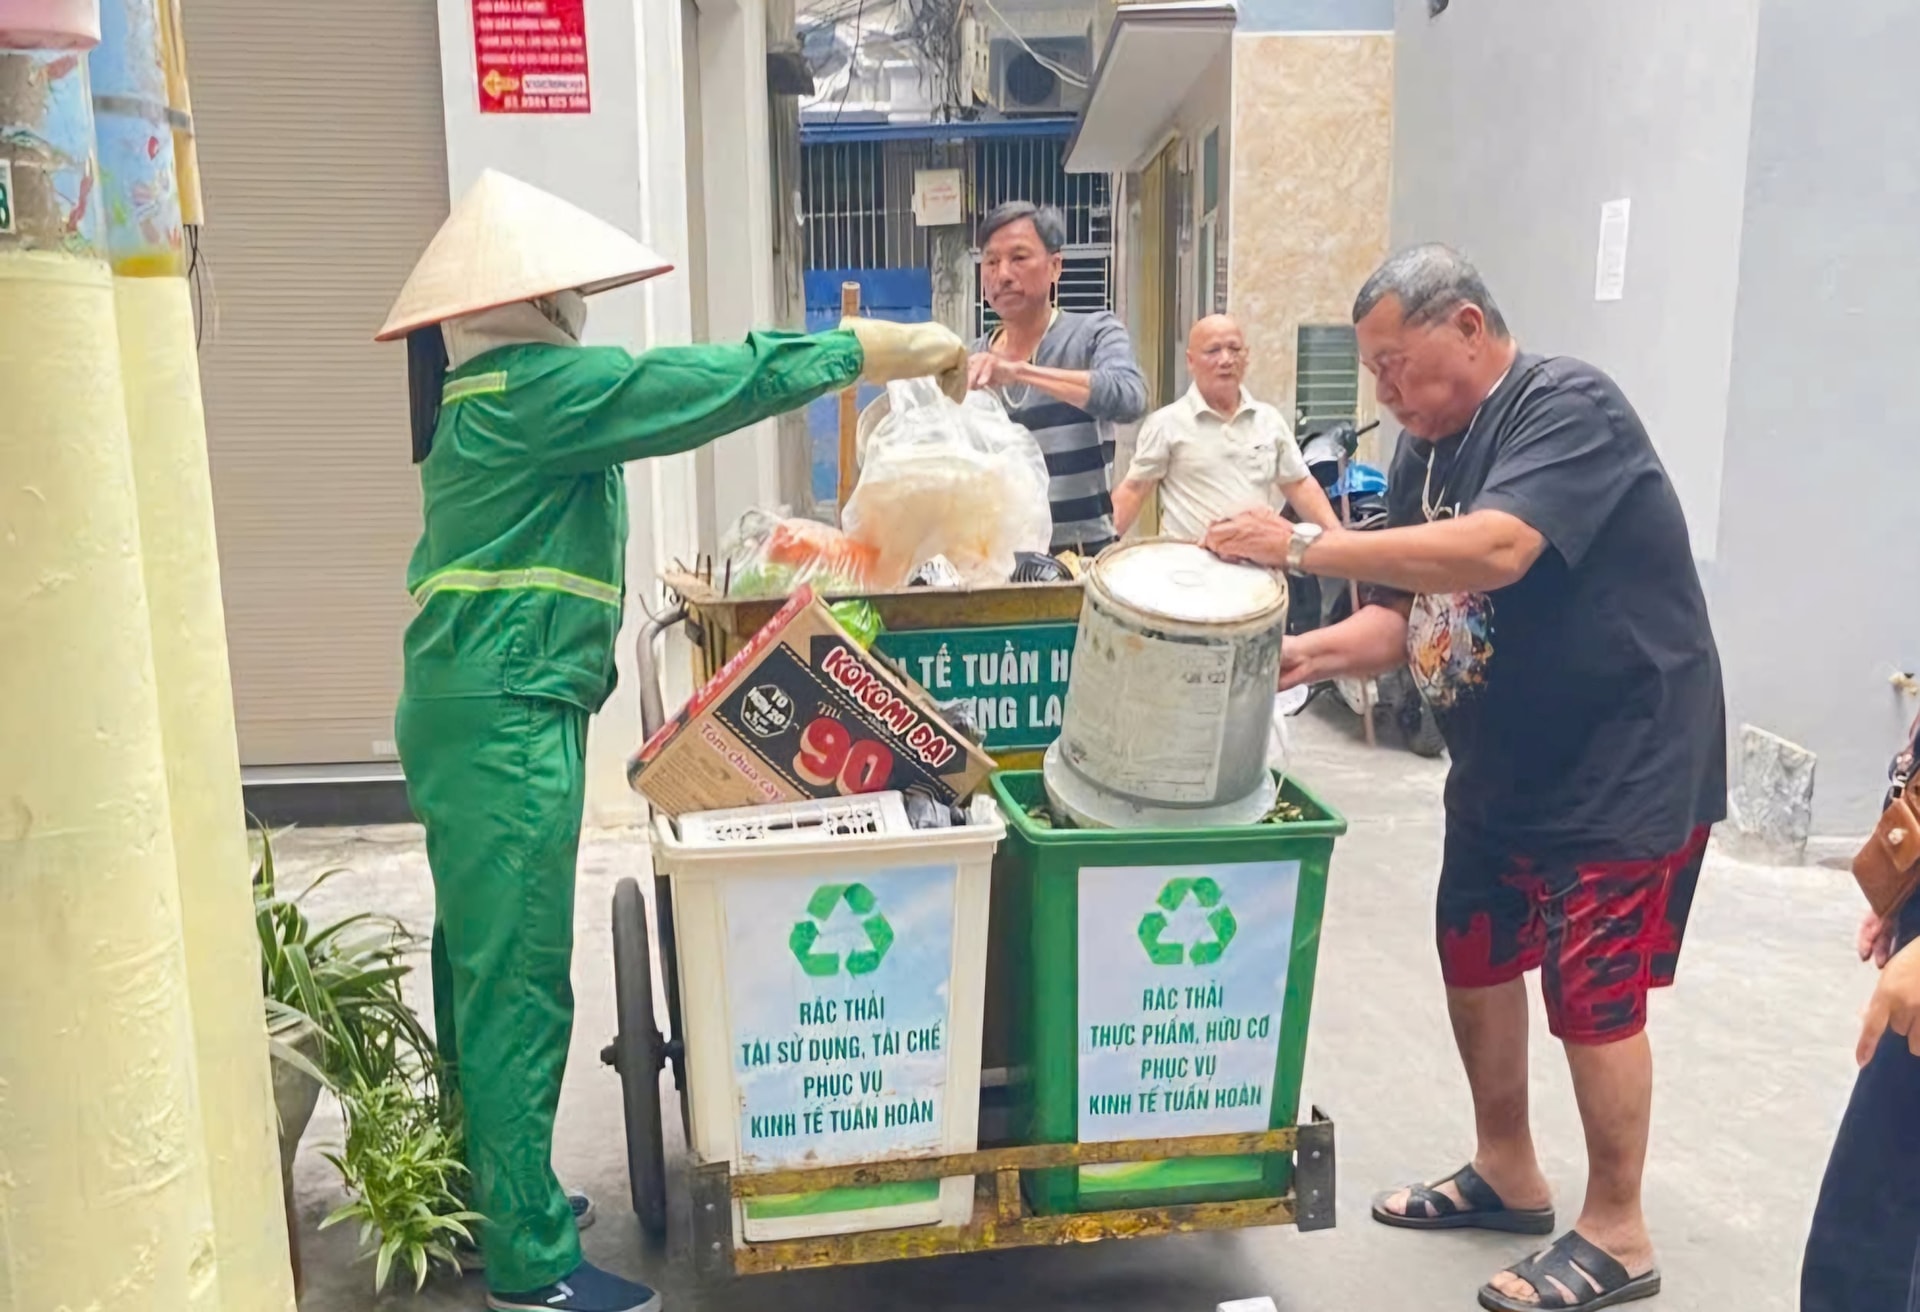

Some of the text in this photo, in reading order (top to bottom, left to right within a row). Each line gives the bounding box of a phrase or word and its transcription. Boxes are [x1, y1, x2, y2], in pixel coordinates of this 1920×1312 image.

[918, 643, 952, 689] TẾ
[962, 640, 1039, 687] TUẦN
[822, 646, 918, 735] KOKOMI
[906, 723, 956, 767] ĐẠI
[966, 695, 1017, 729] NG
[794, 717, 893, 795] 90
[800, 989, 884, 1026] RÁC THẢI
[1185, 979, 1223, 1009] THẢI
[809, 1036, 865, 1066] DỤNG,
[907, 1018, 942, 1053] CHẾ
[1090, 1023, 1135, 1051] THỰC
[1247, 1014, 1270, 1039] CƠ
[803, 1070, 882, 1101] PHỤC VỤ
[1141, 1054, 1217, 1083] PHỤC VỤ
[751, 1113, 796, 1138] KINH
[803, 1105, 823, 1134] TẾ
[885, 1098, 934, 1127] HOÀN
[1089, 1094, 1132, 1115] KINH
[1138, 1084, 1158, 1113] TẾ
